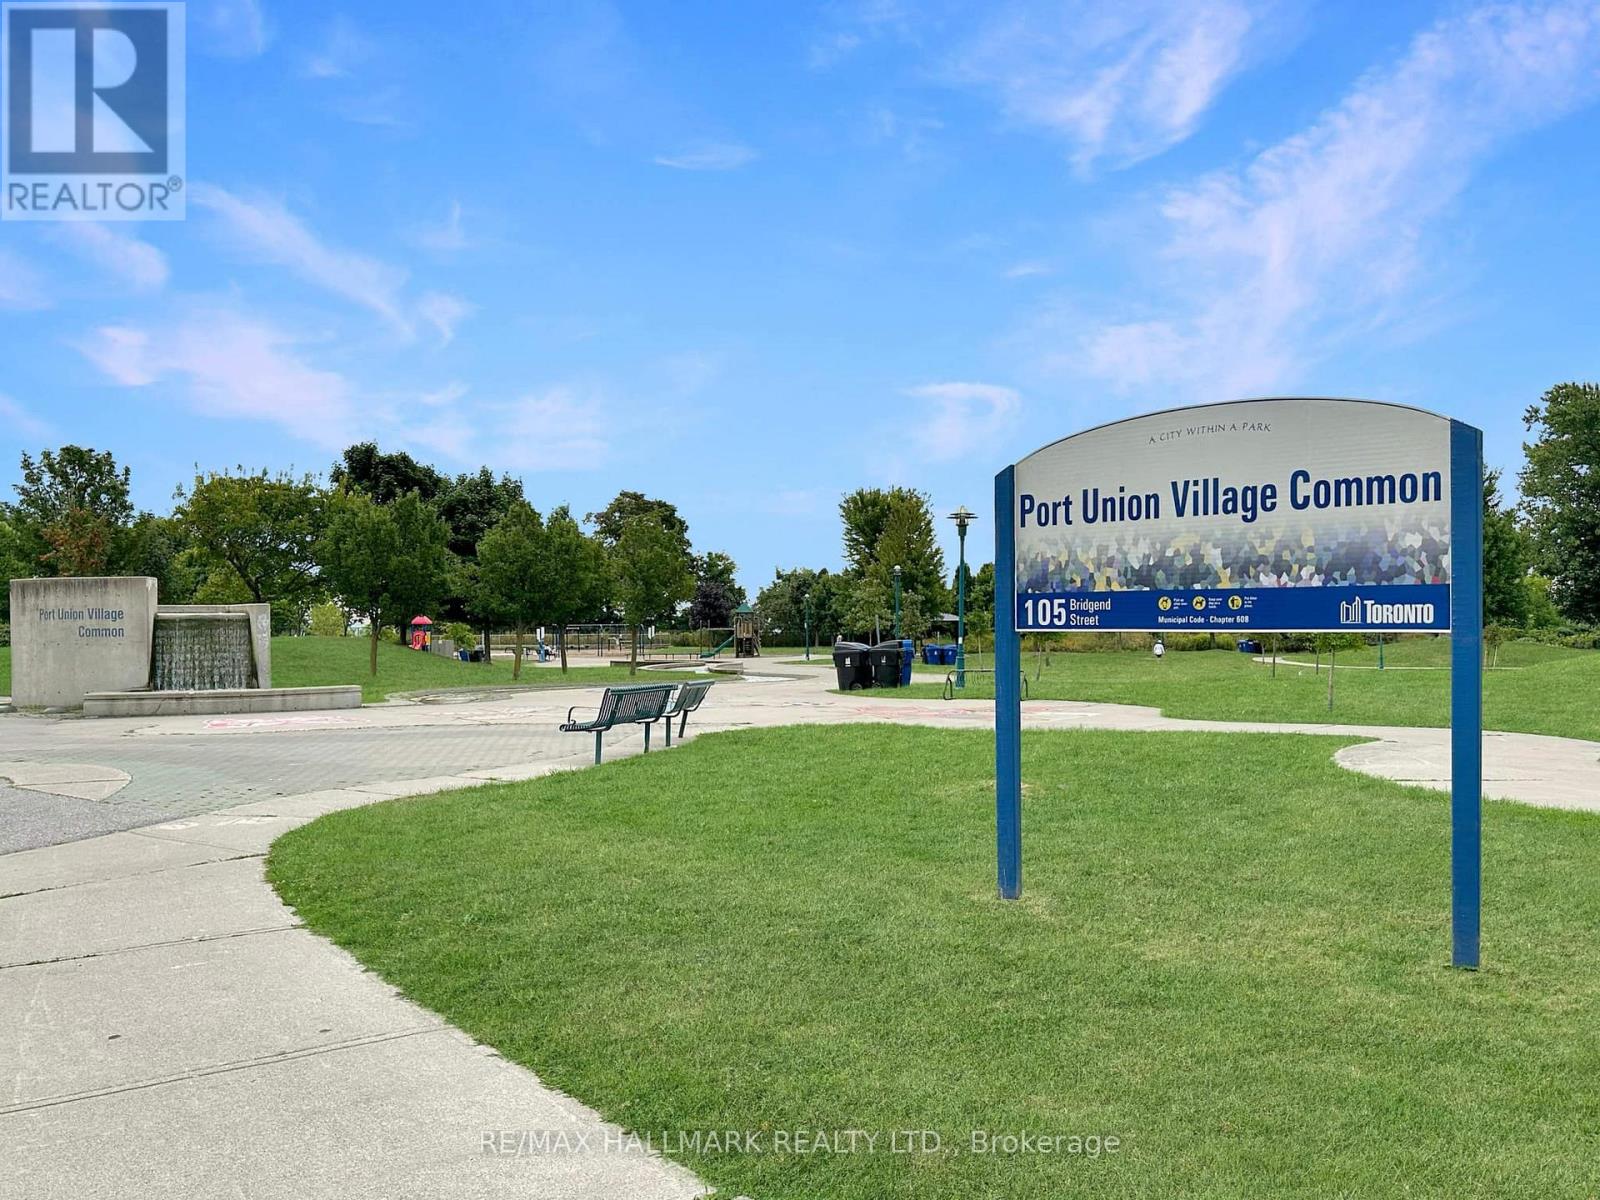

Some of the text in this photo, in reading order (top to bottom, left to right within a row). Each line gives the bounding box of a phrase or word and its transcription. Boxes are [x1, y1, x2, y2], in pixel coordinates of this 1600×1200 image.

[1149, 422, 1271, 444] A CITY WITHIN A PARK
[1020, 469, 1442, 528] Port Union Village Common
[1024, 599, 1066, 626] 105
[1069, 598, 1111, 613] Bridgend
[1363, 600, 1434, 624] TORONTO
[39, 608, 124, 622] Port Union Village
[1069, 613, 1099, 626] Street
[1158, 616, 1188, 624] Municipal
[1209, 616, 1235, 624] Chapter
[78, 625, 124, 637] Common
